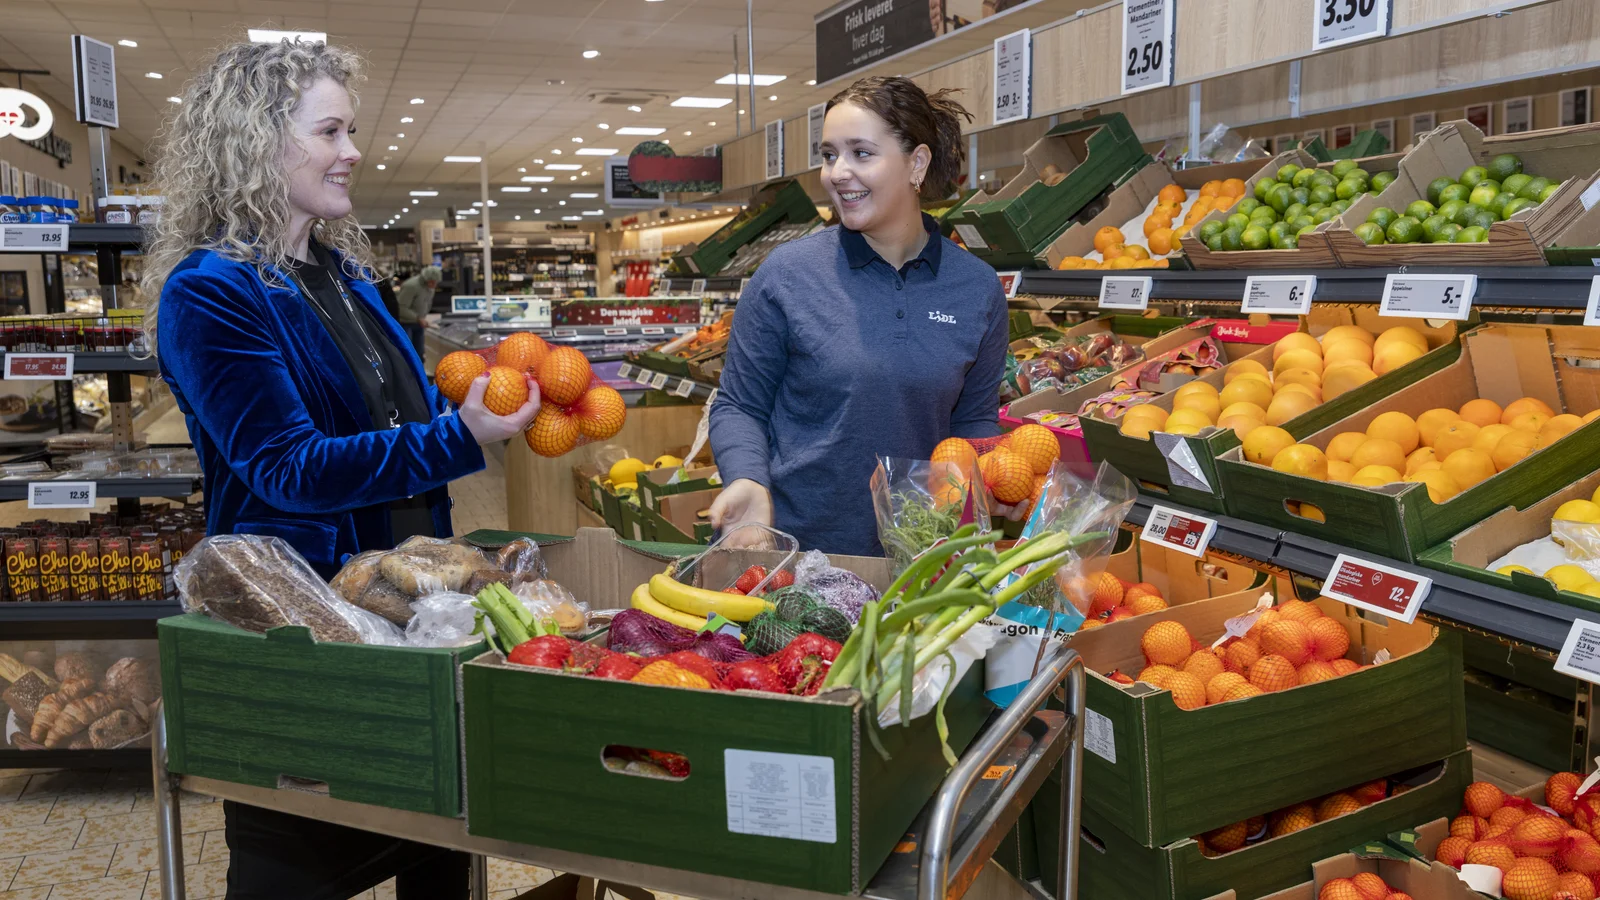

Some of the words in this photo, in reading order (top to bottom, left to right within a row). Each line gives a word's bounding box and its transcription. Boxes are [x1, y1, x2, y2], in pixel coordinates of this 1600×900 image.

[845, 8, 864, 33] Frisk
[864, 0, 893, 24] leveret
[1130, 9, 1162, 24] Mandariner
[852, 32, 869, 51] hver
[869, 24, 885, 44] dag
[1127, 40, 1163, 77] 2.50
[997, 94, 1010, 109] 2.50
[41, 233, 62, 242] 13.95
[1131, 288, 1142, 298] 27.-
[1289, 286, 1304, 301] 6.-
[1441, 286, 1462, 304] 5.-
[600, 308, 614, 316] Den
[619, 307, 653, 319] magiske
[1217, 326, 1233, 336] Pink
[1233, 327, 1250, 338] Lady
[69, 491, 89, 500] 12.95
[1150, 523, 1167, 535] 28,00
[1388, 586, 1411, 603] 12.-
[1587, 643, 1595, 652] kg
